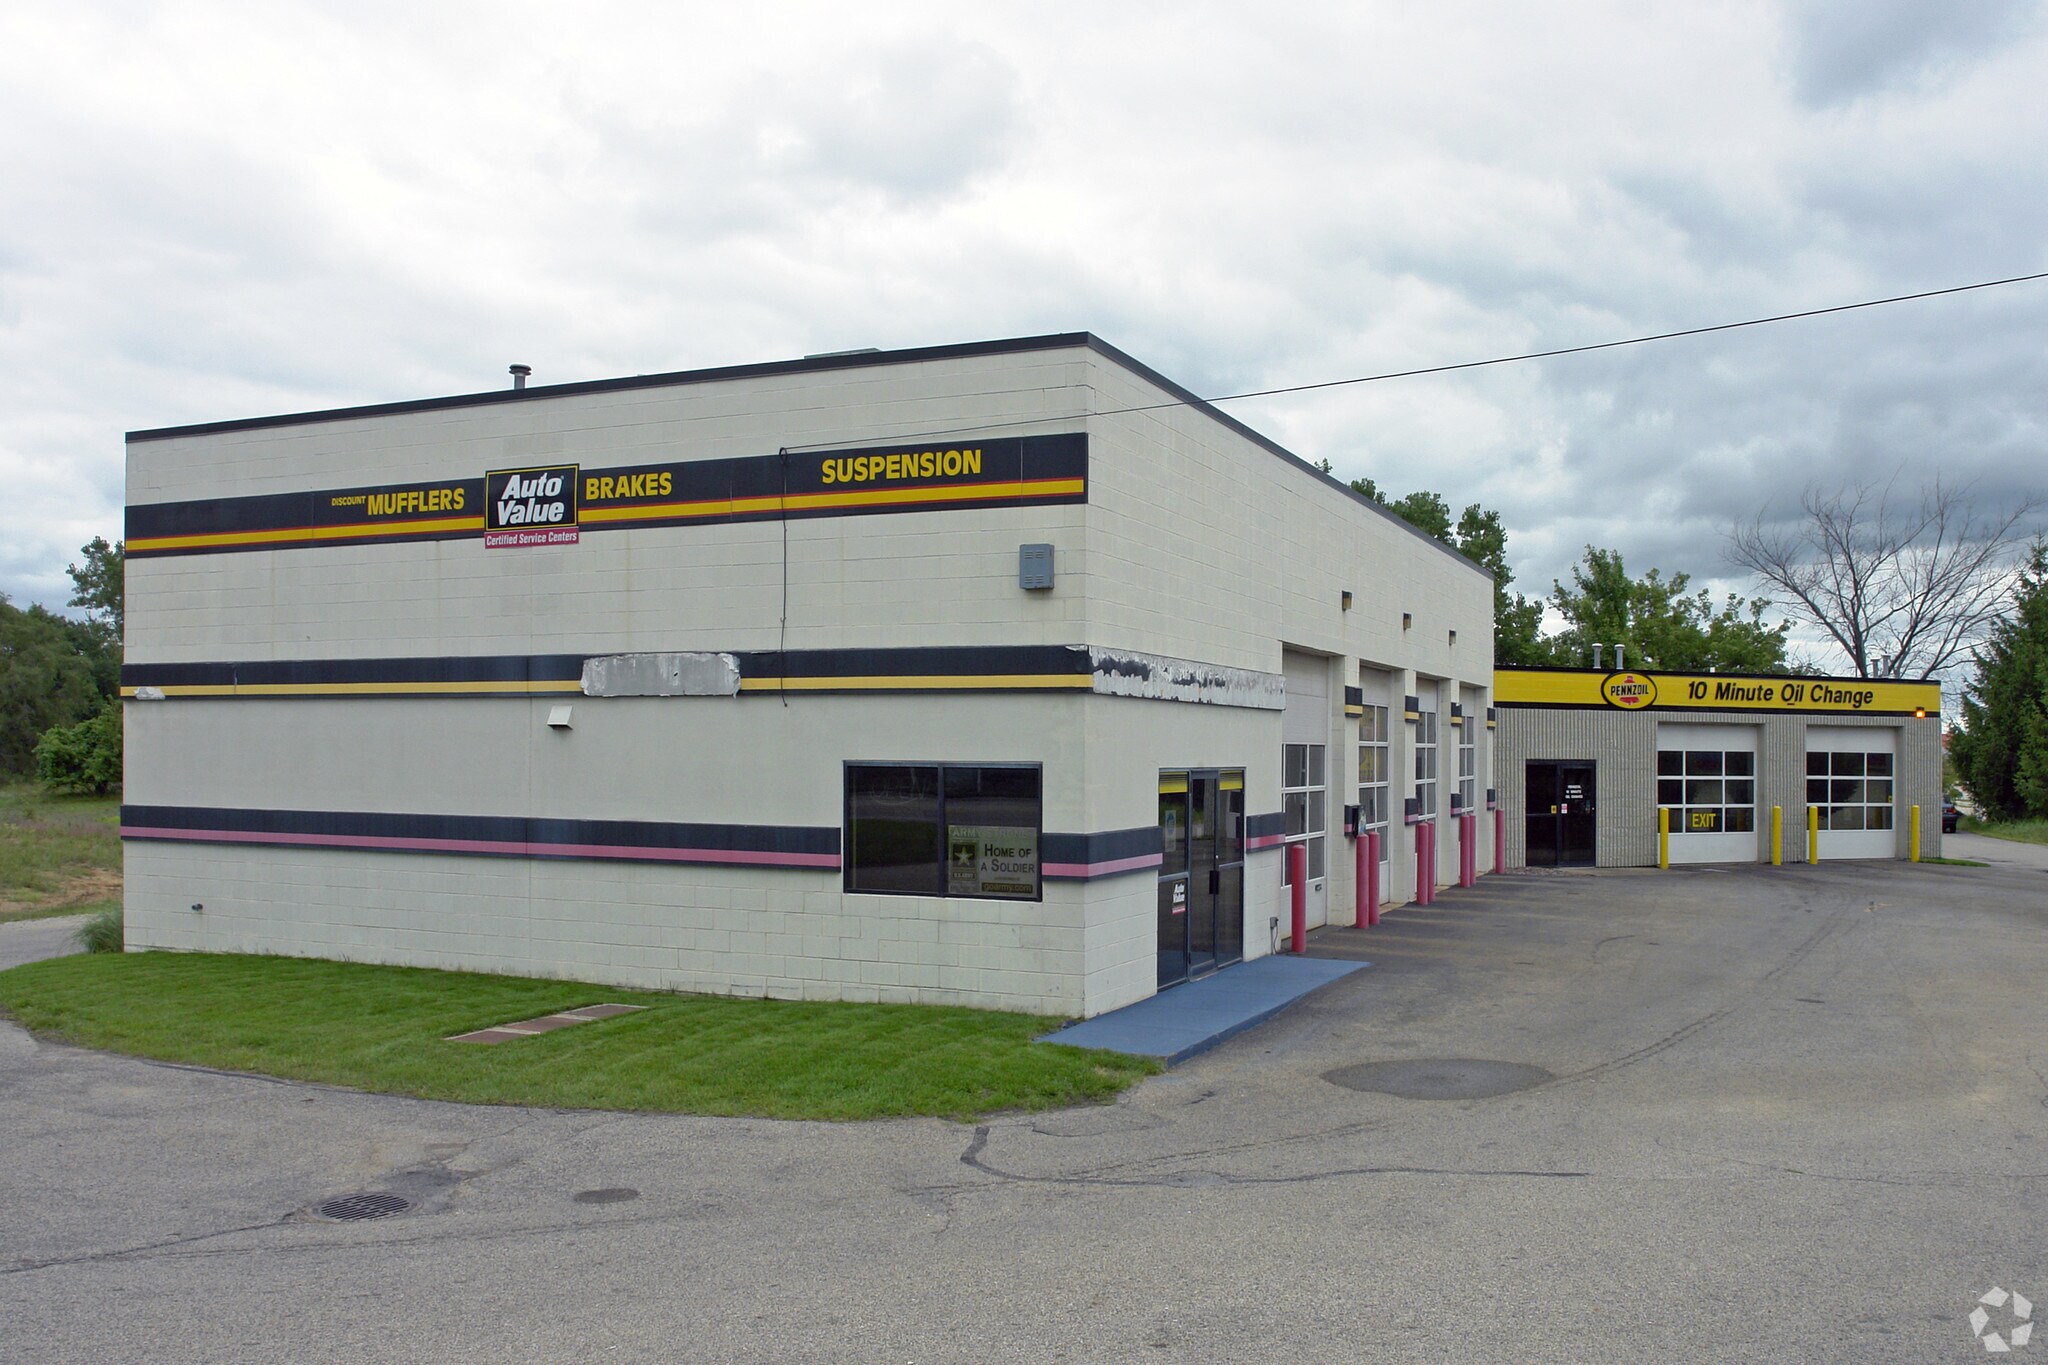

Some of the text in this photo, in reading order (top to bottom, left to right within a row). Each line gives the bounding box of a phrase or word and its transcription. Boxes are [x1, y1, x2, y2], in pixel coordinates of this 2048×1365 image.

[822, 449, 982, 484] SUSPENSION
[501, 473, 562, 500] Auto
[586, 472, 672, 500] BRAKES
[331, 488, 465, 515] DISCOUNT MUFFLERS
[497, 498, 564, 526] Value
[486, 532, 577, 546] Certified Service Centers
[1610, 684, 1649, 696] PENNZOIL
[1688, 681, 1873, 708] 10 Minute Oil Change
[1692, 813, 1716, 827] EXIT
[984, 844, 1032, 858] HOME OF
[991, 859, 1035, 873] SOLDIER
[983, 883, 1032, 893] goarmy.com
